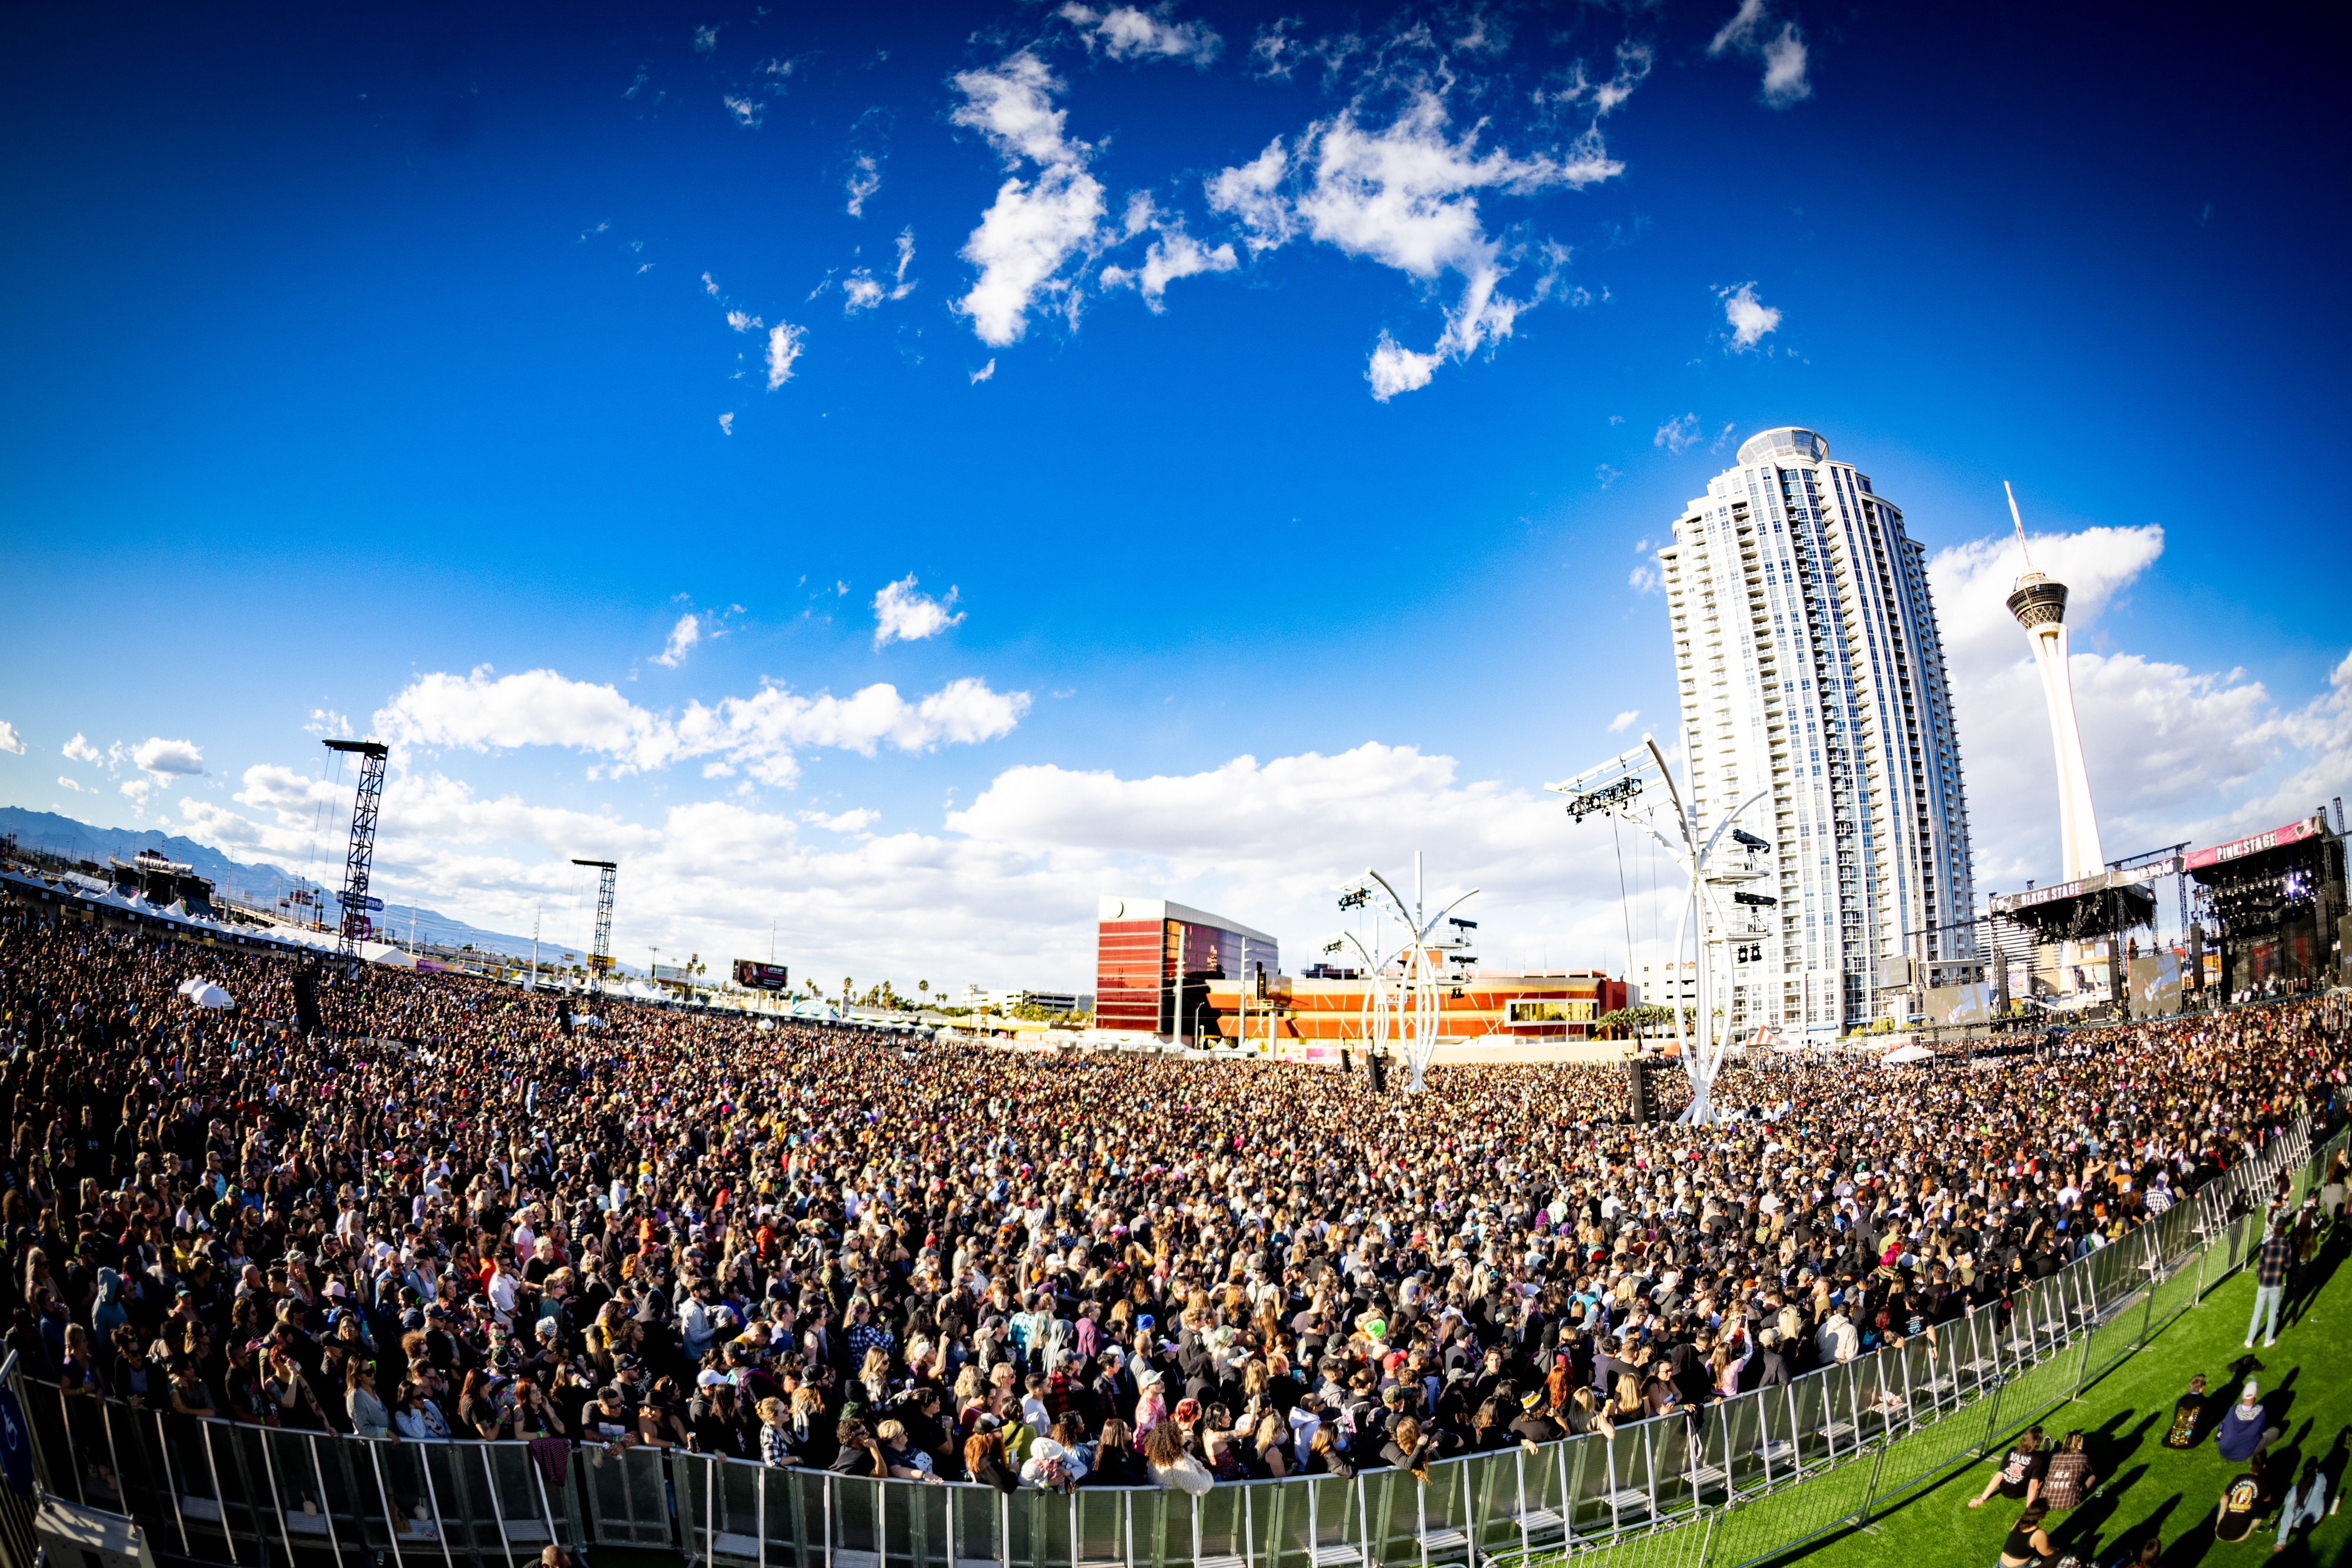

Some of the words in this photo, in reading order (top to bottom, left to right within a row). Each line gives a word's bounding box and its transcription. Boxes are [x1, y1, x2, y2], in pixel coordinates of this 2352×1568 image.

[2216, 843, 2241, 861] PINK
[2243, 833, 2276, 854] STAGE
[2020, 890, 2049, 906] BLACK
[2051, 882, 2080, 901] STAGE
[2009, 1452, 2032, 1466] VANS
